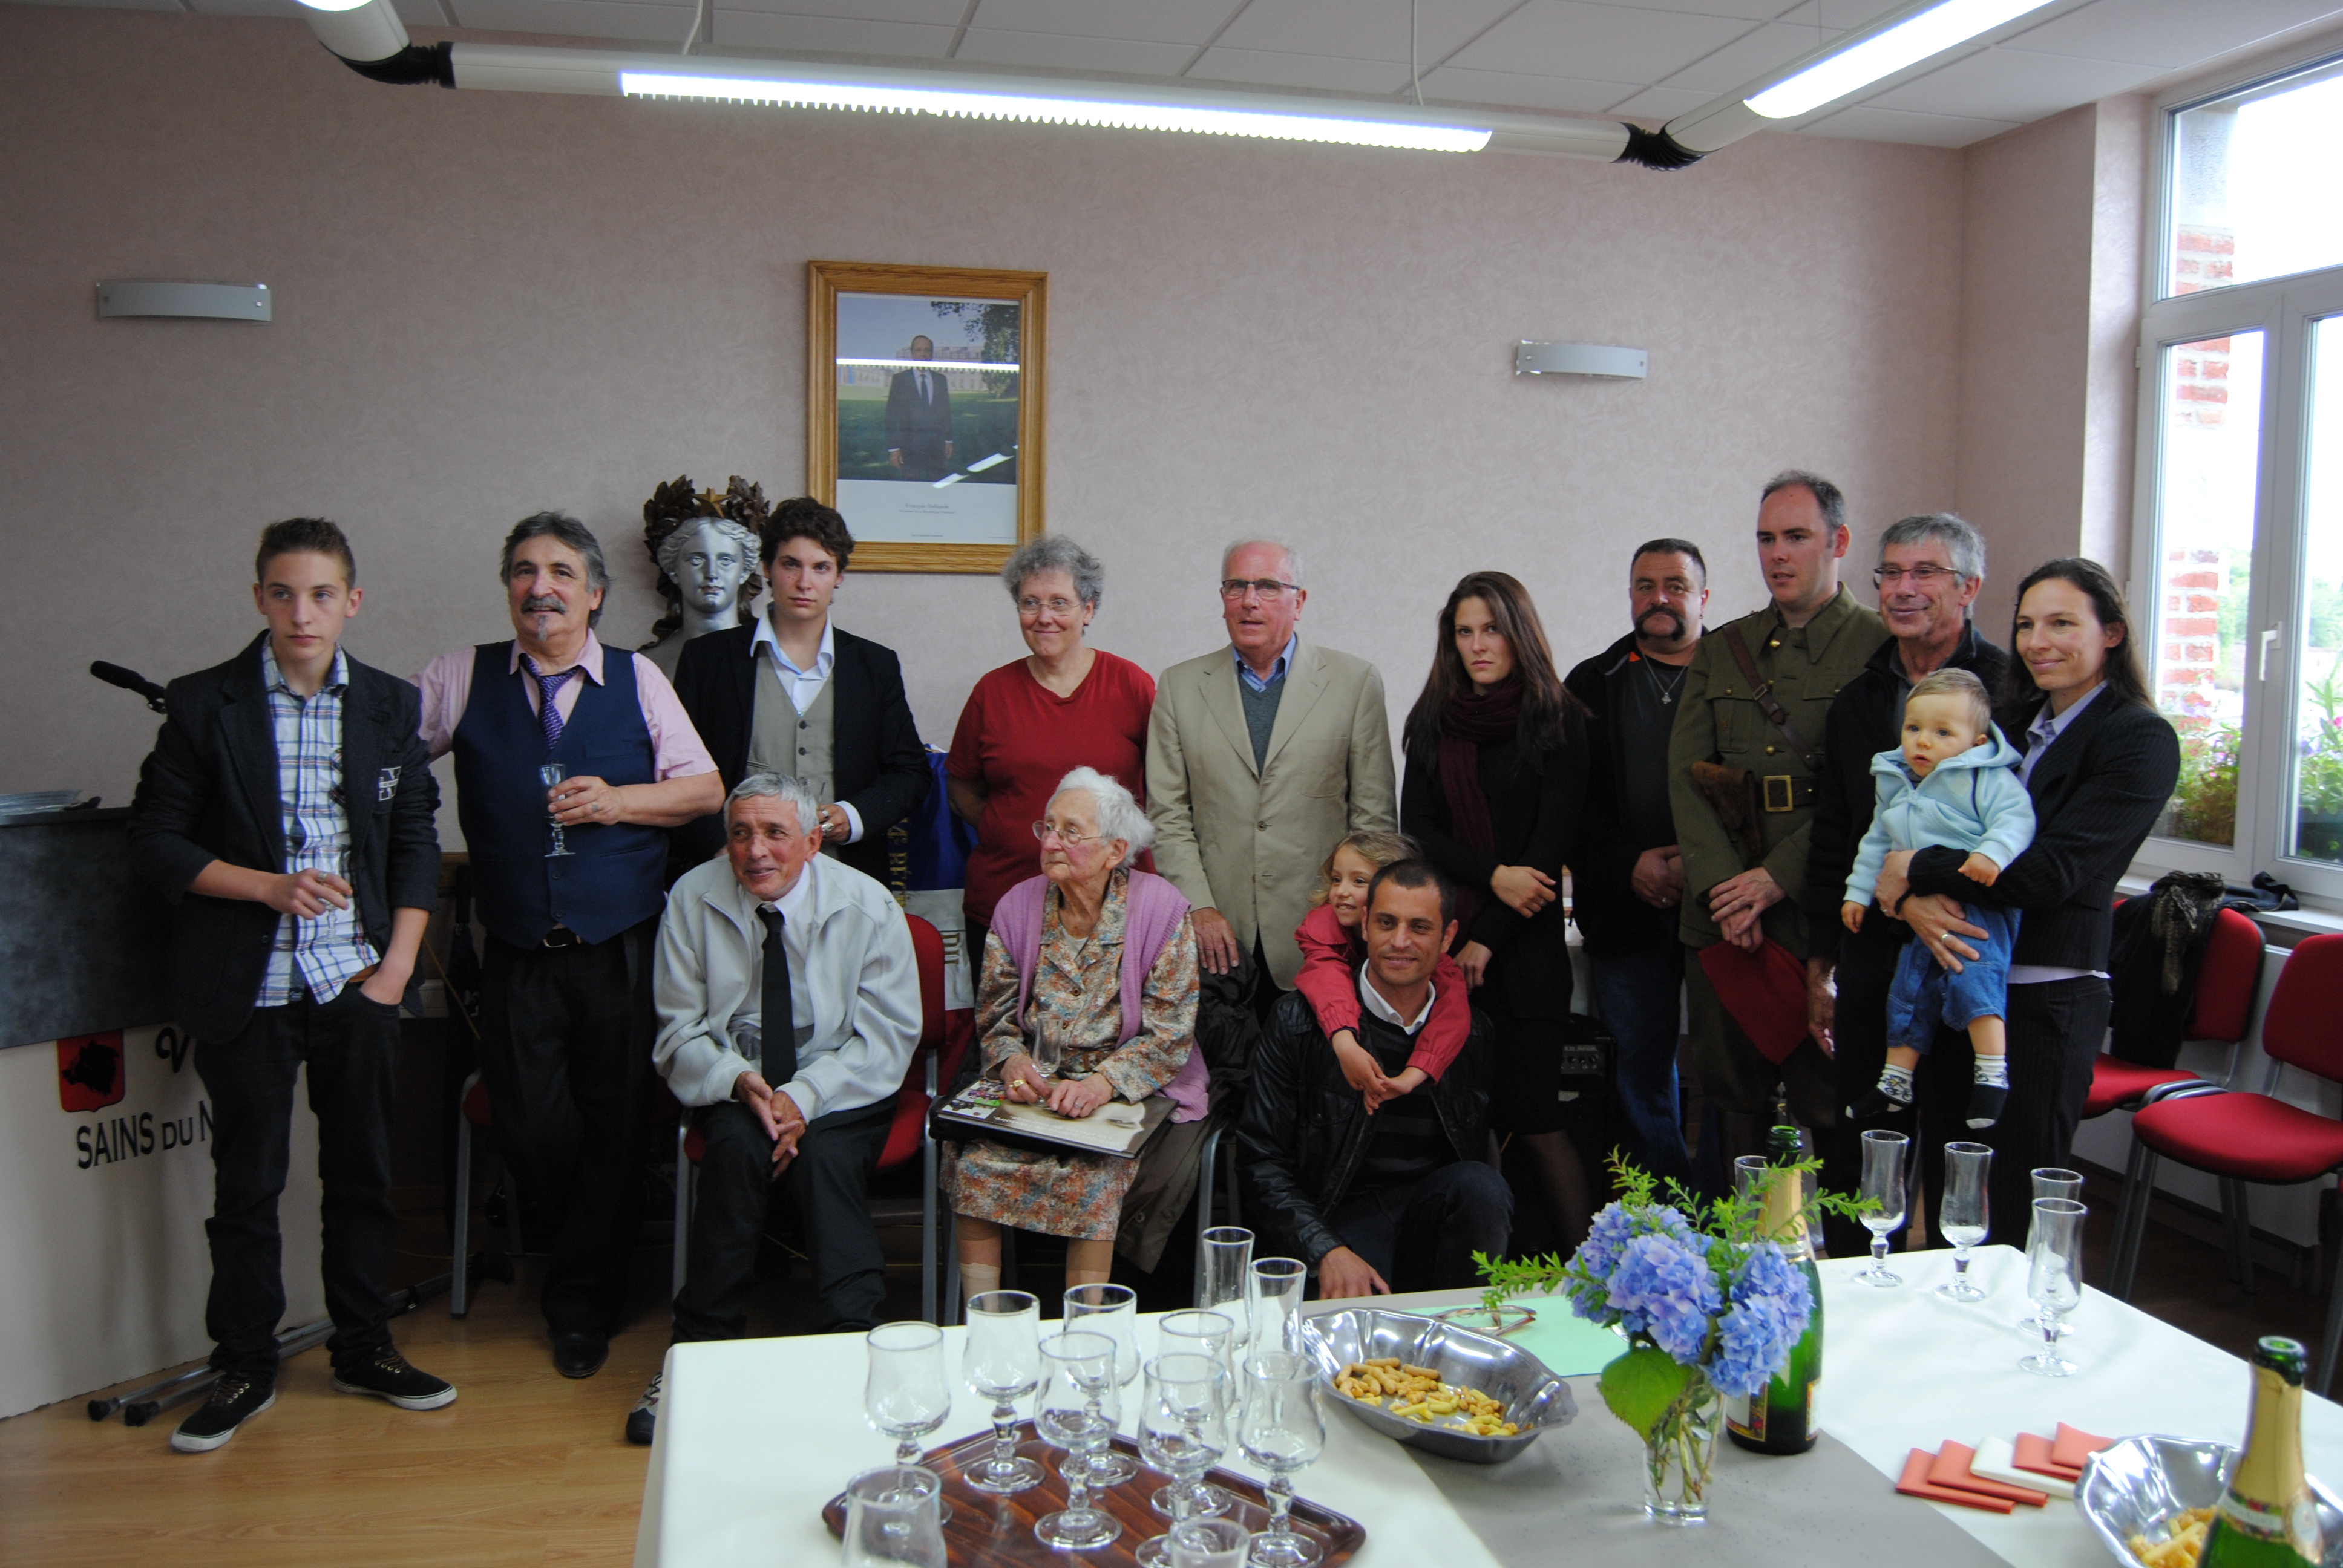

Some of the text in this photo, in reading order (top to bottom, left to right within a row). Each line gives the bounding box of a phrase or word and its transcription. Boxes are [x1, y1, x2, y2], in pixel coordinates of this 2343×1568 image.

[155, 1027, 191, 1073] V
[76, 1100, 214, 1170] SAINS DU N
